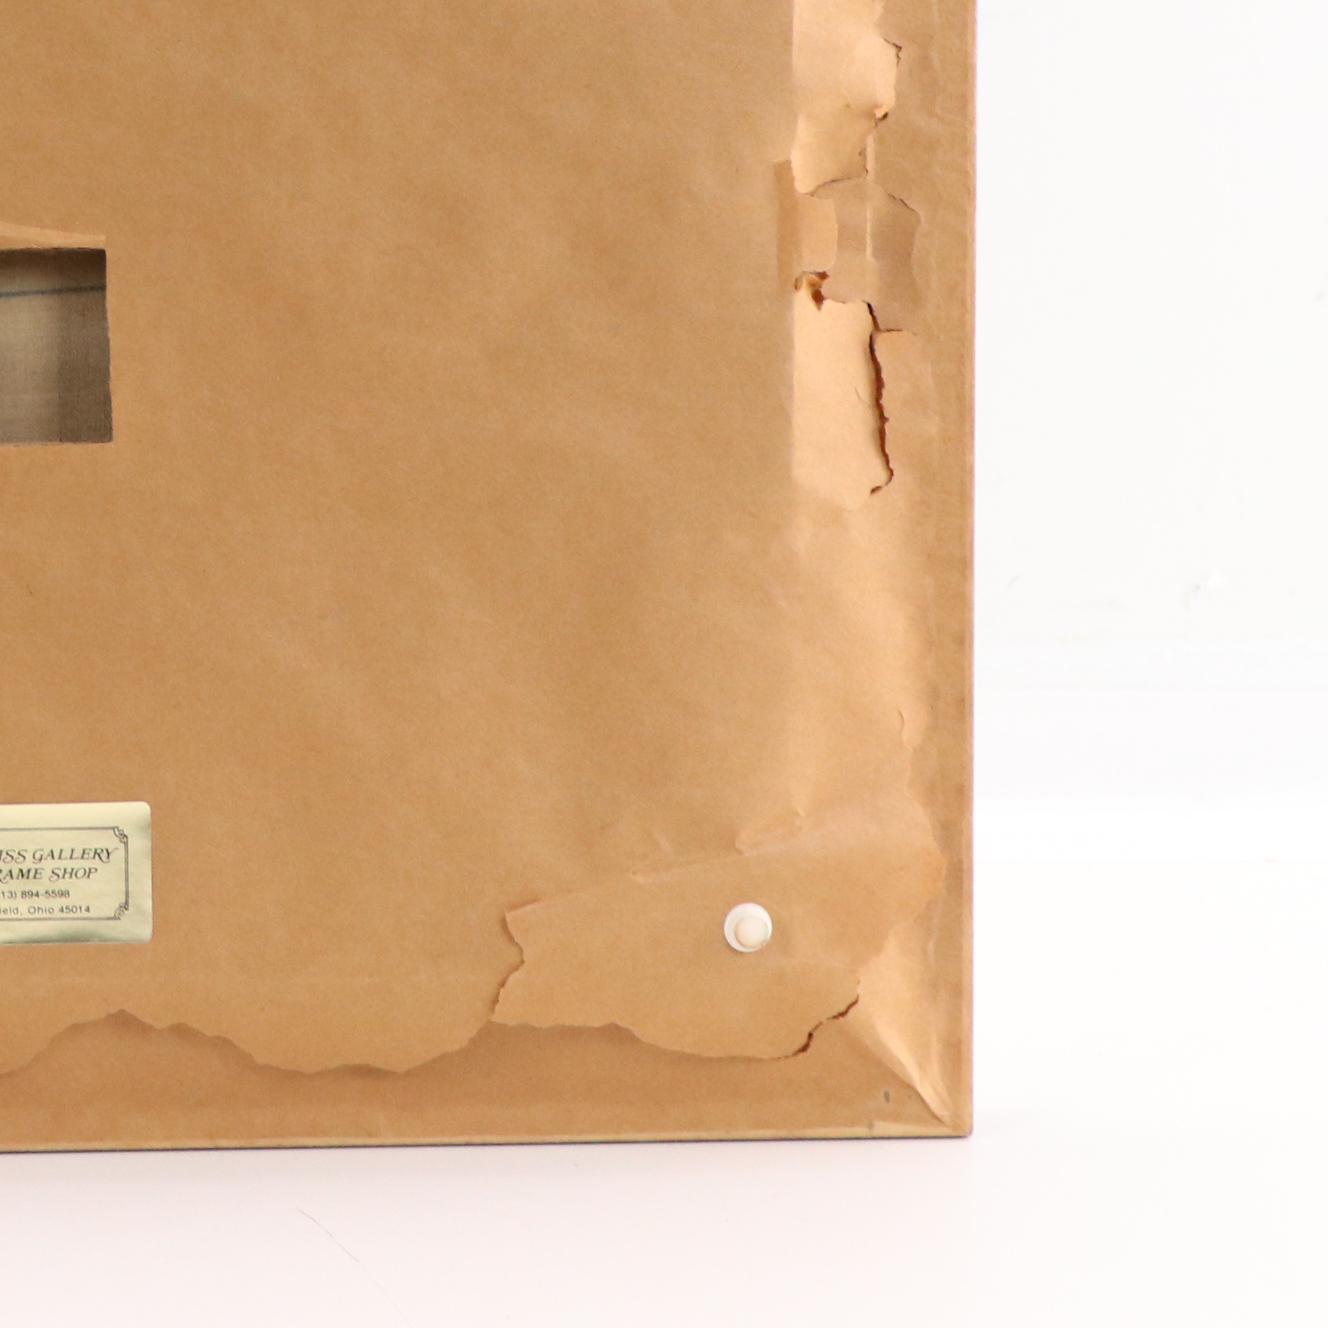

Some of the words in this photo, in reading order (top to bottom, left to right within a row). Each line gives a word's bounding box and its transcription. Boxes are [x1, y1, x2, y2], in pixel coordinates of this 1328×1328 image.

[32, 847, 118, 863] GALLERY
[48, 867, 98, 881] SHOP
[21, 890, 70, 899] 894-5598
[28, 906, 54, 915] Ohio
[58, 905, 91, 914] 45014
